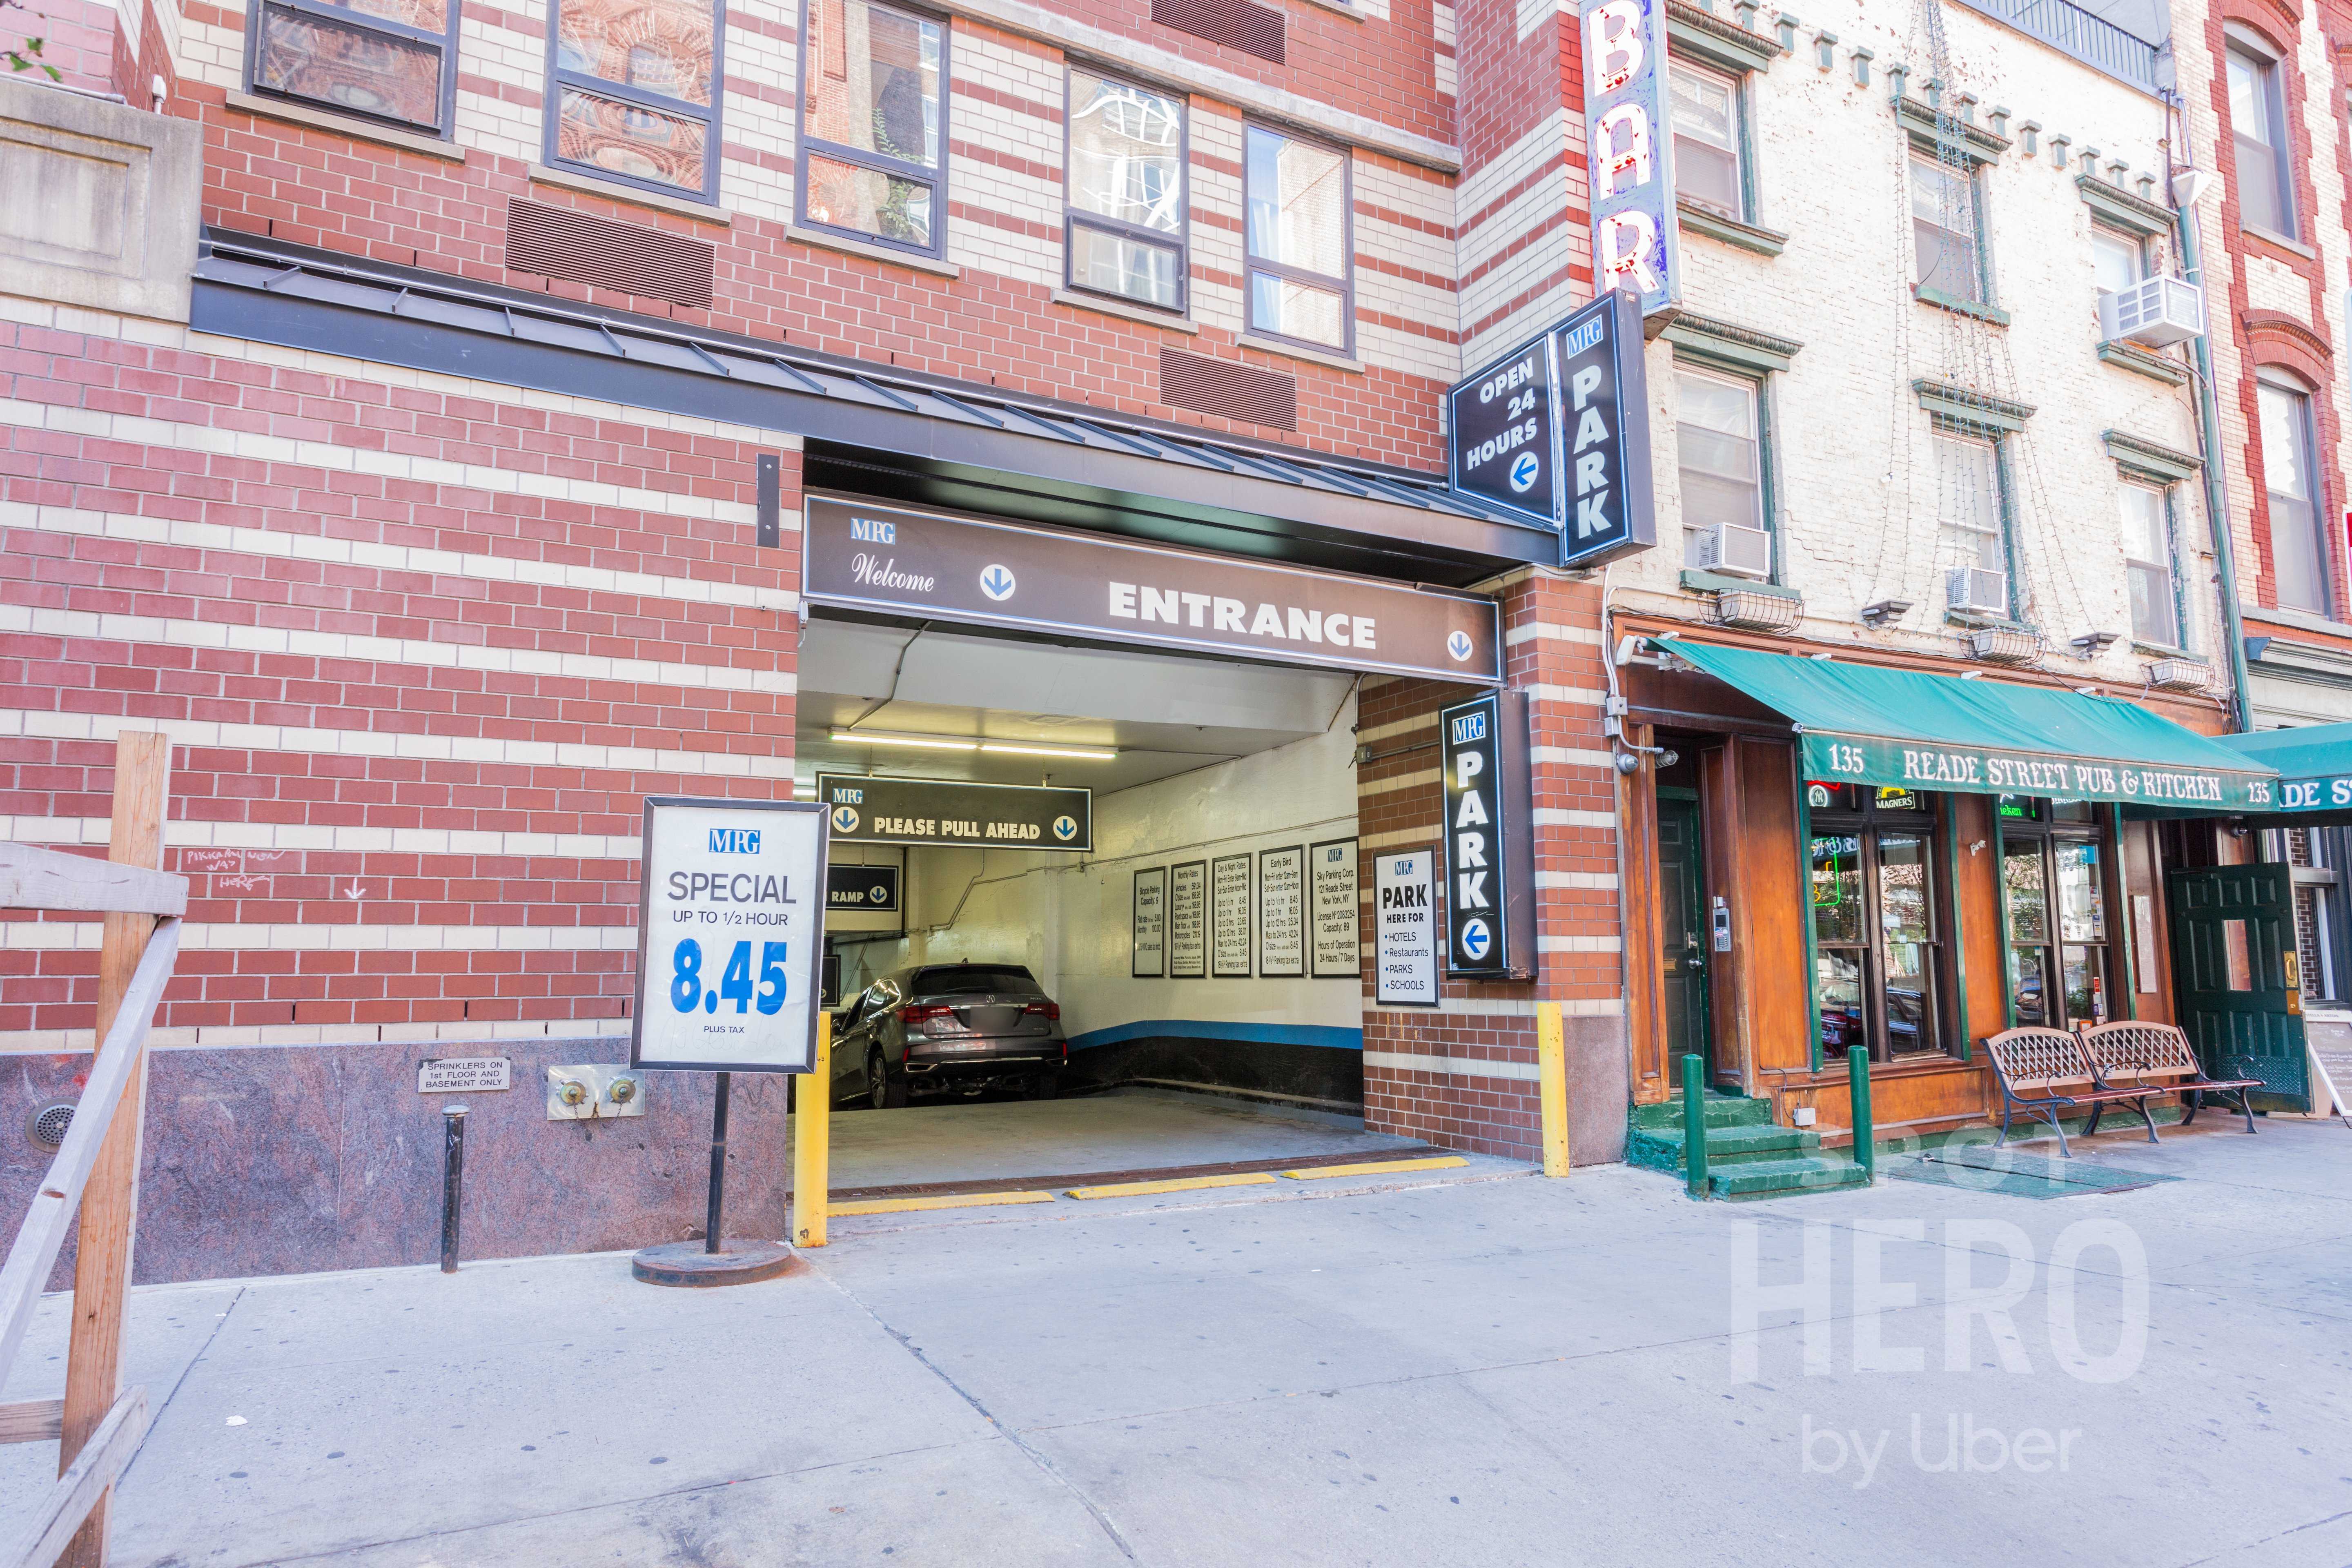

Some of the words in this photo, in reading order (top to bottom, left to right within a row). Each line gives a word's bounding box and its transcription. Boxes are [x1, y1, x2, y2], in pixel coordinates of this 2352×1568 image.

[1589, 0, 1659, 293] BAR
[1567, 316, 1602, 359] MPG
[1480, 357, 1533, 403] OPEN
[1508, 388, 1535, 421] 24
[1468, 417, 1537, 471] HOURS
[1573, 365, 1612, 539] PARK
[851, 518, 895, 544] MPG
[852, 553, 934, 592] Welcome
[1109, 582, 1376, 649] ENTRANCE
[1454, 714, 1483, 743] MPG
[1829, 744, 1864, 773] 135
[1903, 750, 1981, 784] READE
[1987, 757, 2069, 790] STREET
[2074, 765, 2116, 793] PUB
[2121, 770, 2138, 795] &
[2140, 771, 2223, 801] KITCHEN
[2247, 782, 2270, 803] 135
[833, 788, 862, 804] MPG
[1876, 797, 1912, 809] MAGNERS
[874, 817, 935, 835] PLEASE
[942, 821, 980, 837] PULL
[986, 822, 1040, 839] AHEAD
[1456, 751, 1490, 909] PARK
[709, 829, 760, 854] MPG
[1328, 848, 1342, 862] MPG
[1237, 861, 1246, 869] Rates
[1271, 859, 1281, 868] Early
[1283, 857, 1291, 866] Bird
[1395, 860, 1412, 875] MPG
[1178, 871, 1189, 880] Monthly
[1326, 869, 1341, 880] Parking
[1343, 868, 1354, 878] Corp.
[667, 871, 796, 904] SPECIAL
[1140, 886, 1149, 896] Bicycle
[1150, 885, 1160, 895] Parking
[1265, 884, 1275, 893] Sat-Sun
[1325, 883, 1338, 893] Reade
[1340, 882, 1353, 891] Street
[832, 891, 864, 902] RAMP
[1266, 898, 1270, 907] Up
[1323, 896, 1331, 905] New
[1332, 895, 1342, 905] York,
[1343, 894, 1349, 903] NY
[1383, 884, 1428, 909] PARK
[1266, 909, 1270, 918] Up
[1289, 906, 1298, 915] 16.05
[1317, 911, 1332, 921] License
[1337, 909, 1355, 920] 2083254
[1387, 913, 1406, 923] HERE
[1409, 913, 1424, 922] FOR
[673, 911, 693, 923] UP
[698, 911, 717, 924] TO
[746, 913, 788, 926] HOUR
[1218, 919, 1222, 928] Up
[1237, 917, 1246, 925] 23.65
[1266, 919, 1270, 929] Up
[1288, 917, 1298, 926] 25.34
[1137, 925, 1147, 934] Monthly
[1152, 924, 1161, 932] 100.00
[1218, 929, 1222, 938] Up
[1289, 929, 1298, 938] 42.24
[1323, 922, 1342, 933] Capacity:
[1344, 922, 1349, 931] 89
[1175, 931, 1190, 940] Motorcycles
[1390, 932, 1416, 942] HOTELS
[1318, 940, 1329, 950] Hours
[1330, 940, 1334, 949] of
[1336, 939, 1355, 950] Operation
[1390, 947, 1428, 957] Restaurants
[1225, 960, 1235, 969] Parking
[1274, 956, 1285, 966] Parking
[1320, 953, 1325, 962] 24
[1344, 953, 1355, 964] Days
[1390, 964, 1412, 973] PARKS
[670, 938, 787, 1015] 8.45
[1390, 981, 1424, 990] SCHOOLS
[428, 1062, 486, 1070] SPRINKLERS
